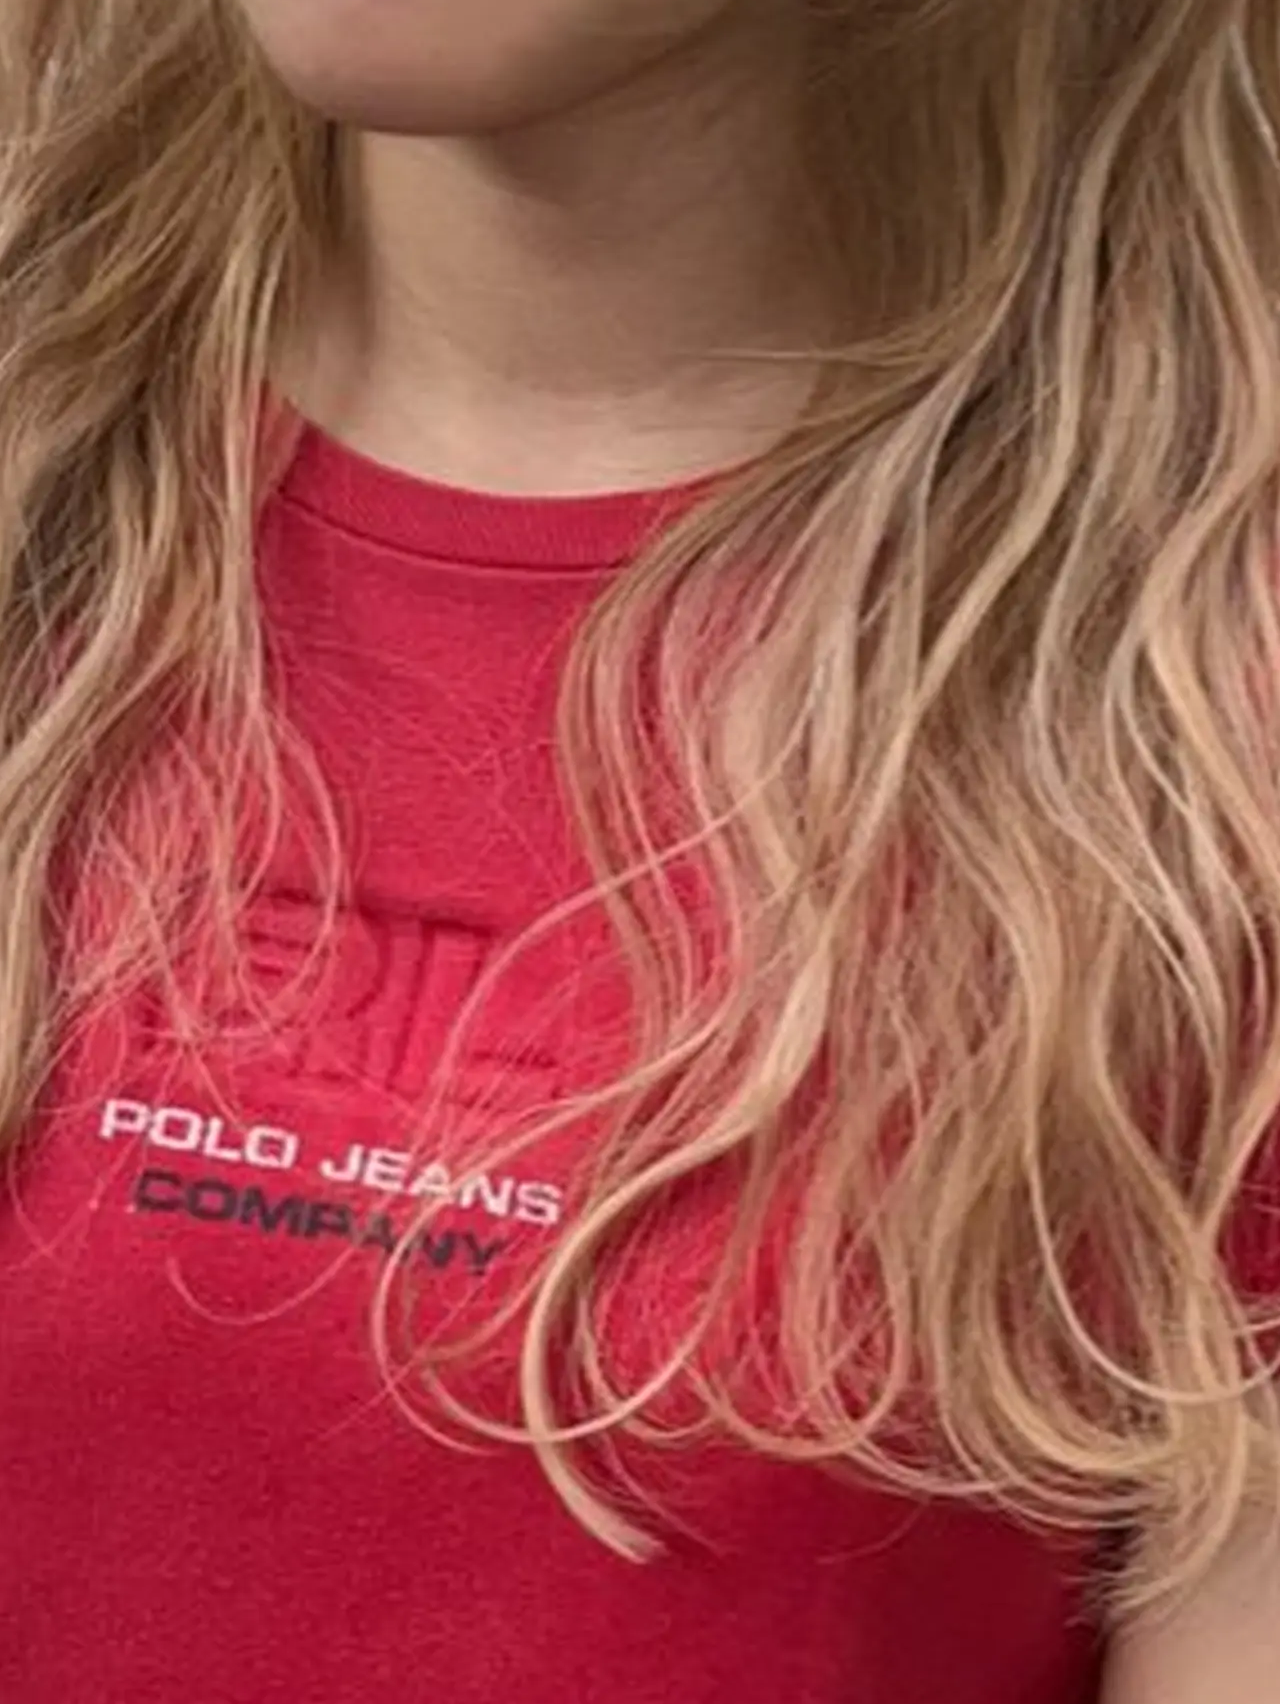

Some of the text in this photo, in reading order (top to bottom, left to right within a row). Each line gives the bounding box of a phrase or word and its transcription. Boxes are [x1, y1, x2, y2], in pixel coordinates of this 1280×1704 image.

[99, 1098, 563, 1226] POLO JEANS
[131, 1169, 507, 1276] COMPANY
